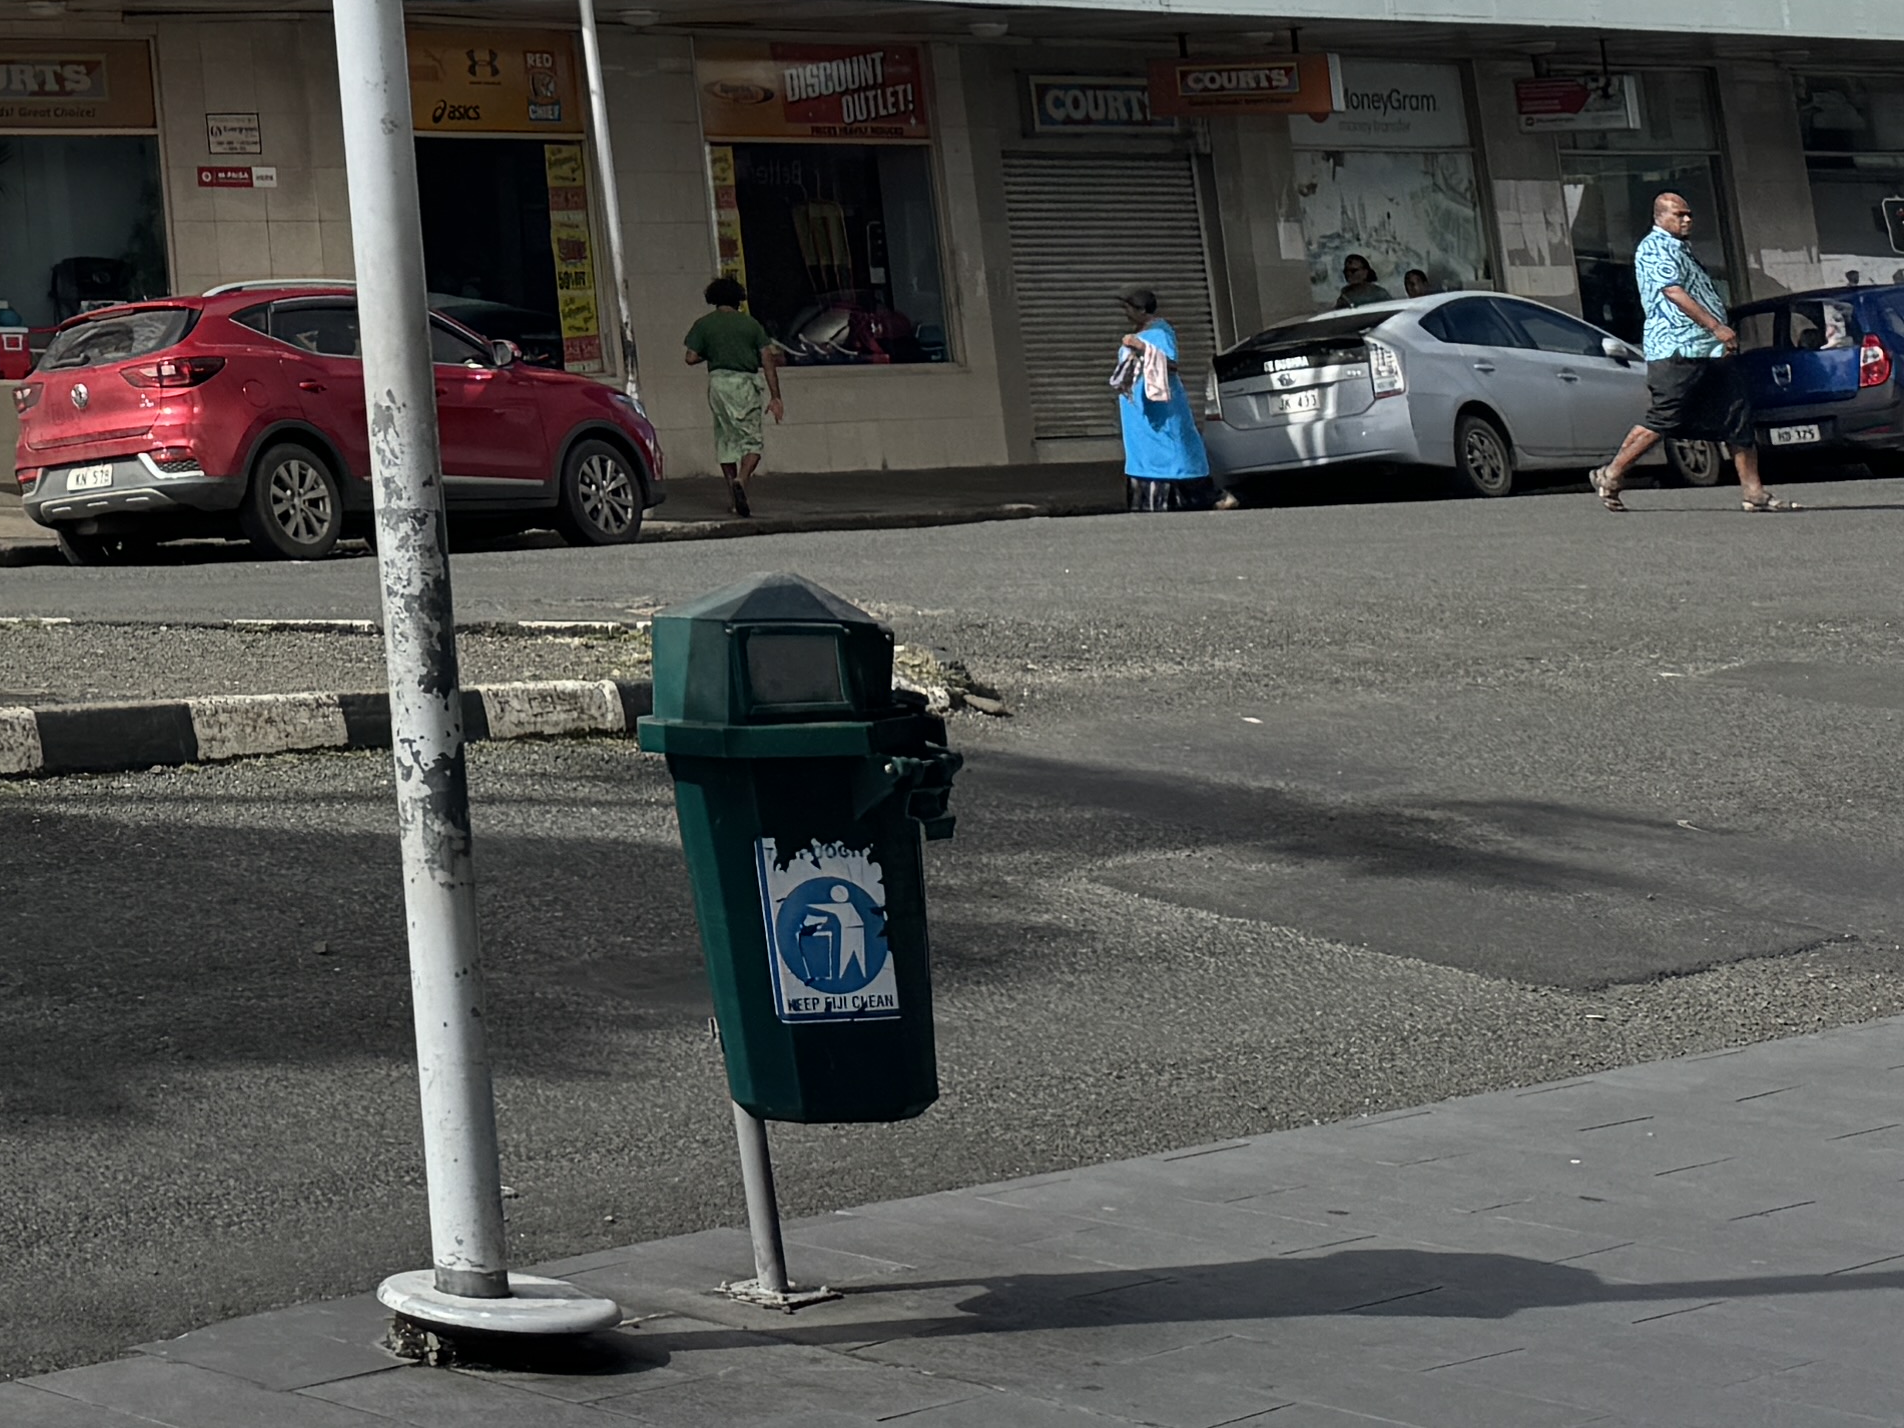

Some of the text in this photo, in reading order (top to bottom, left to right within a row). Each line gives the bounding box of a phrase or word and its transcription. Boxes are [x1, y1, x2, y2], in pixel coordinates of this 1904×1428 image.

[526, 53, 553, 68] RED
[784, 50, 885, 103] DISCOUNT
[1186, 69, 1289, 90] COURTS
[18, 107, 51, 117] Great
[53, 107, 96, 118] Choice!
[447, 104, 480, 121] asics
[842, 82, 914, 125] OUTLET!
[1045, 88, 1149, 121] COURT
[1344, 88, 1437, 116] oneyGram
